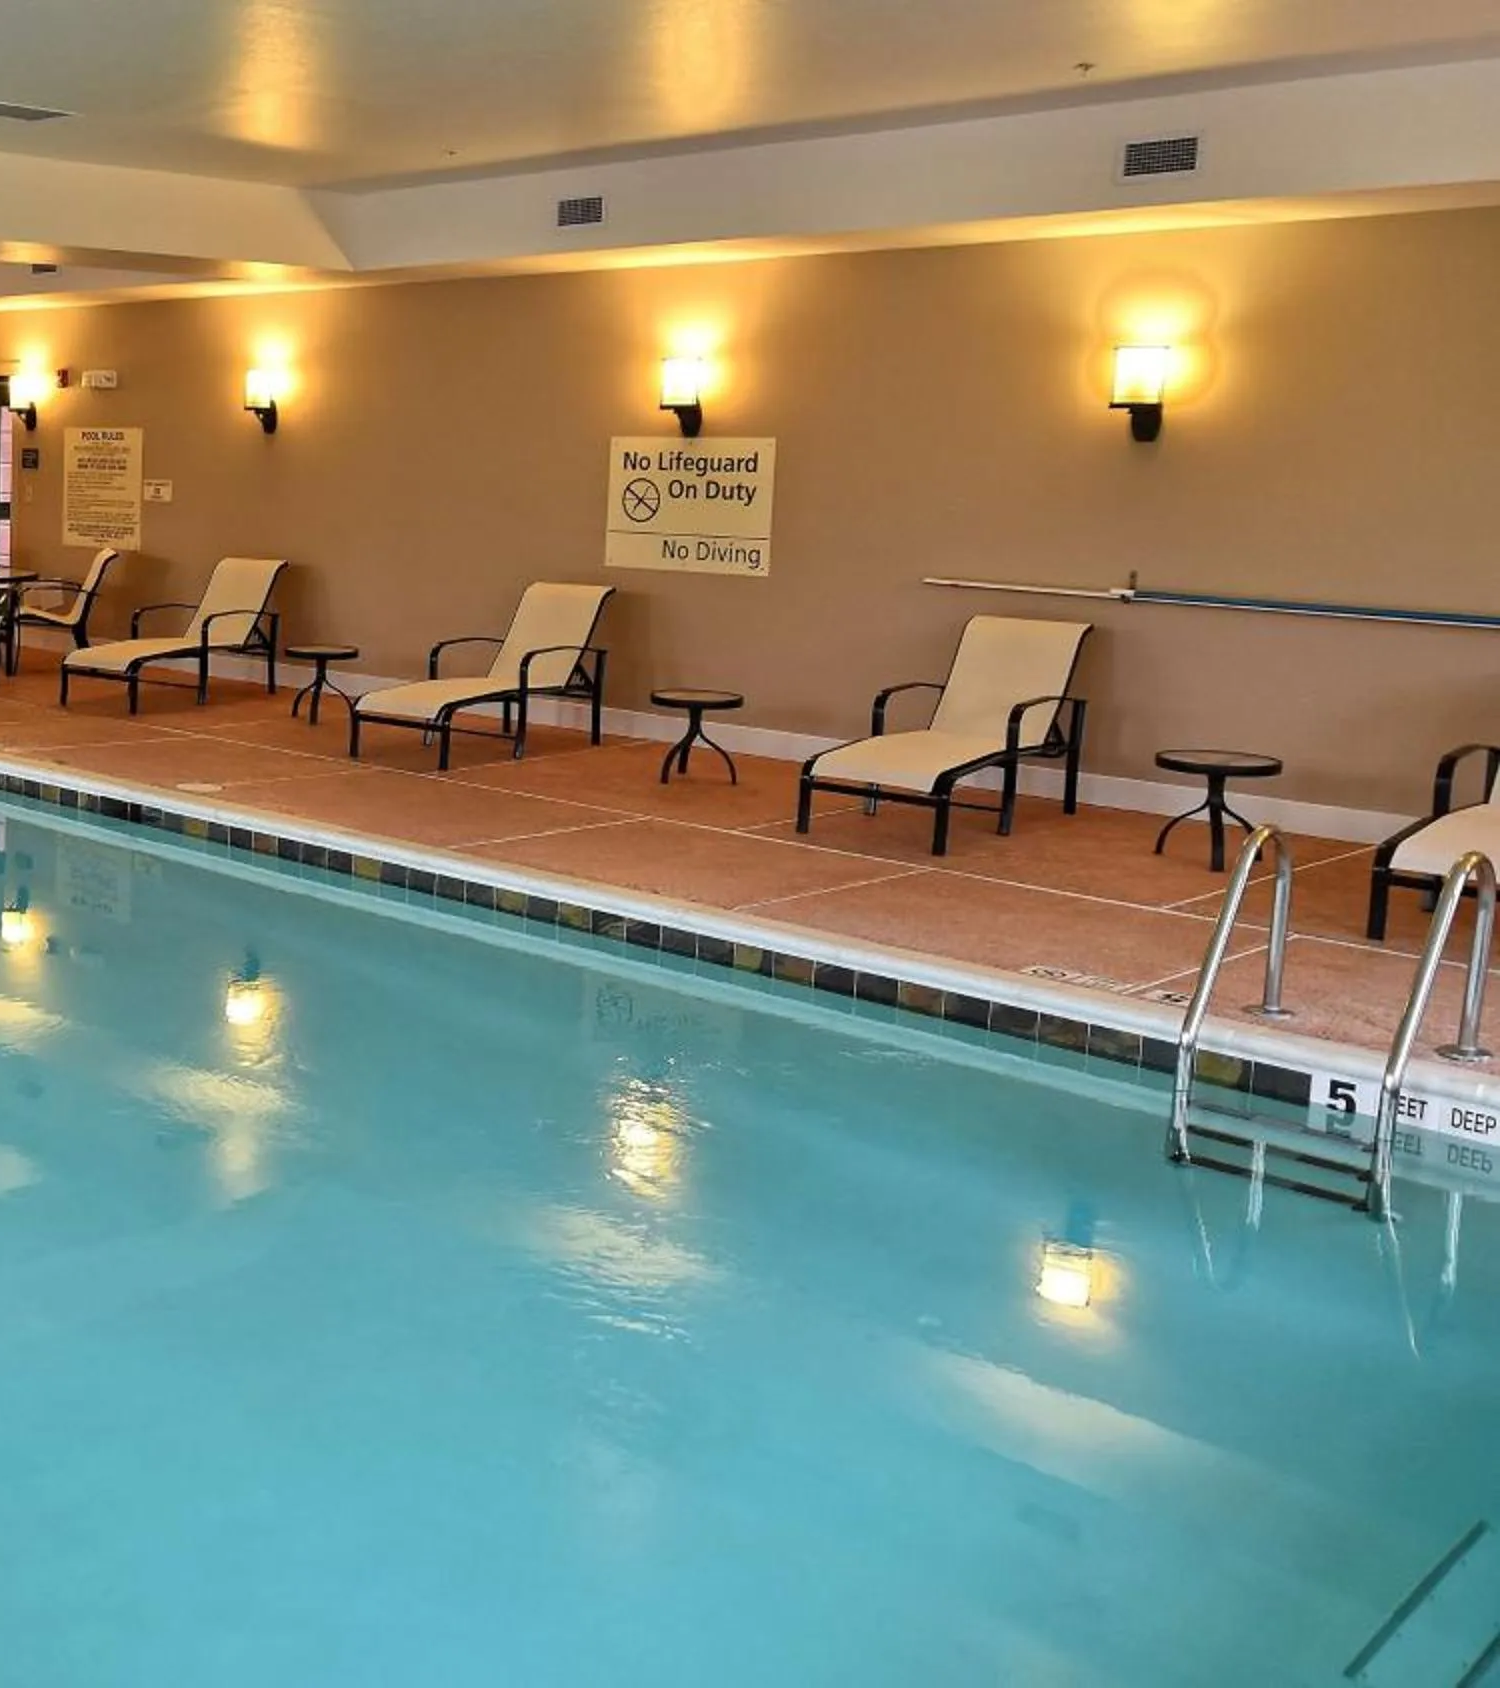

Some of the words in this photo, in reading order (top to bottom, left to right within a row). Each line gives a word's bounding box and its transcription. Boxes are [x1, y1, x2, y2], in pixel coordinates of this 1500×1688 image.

[623, 451, 651, 471] No
[658, 451, 759, 477] Lifeguard
[668, 479, 697, 499] On
[705, 480, 757, 507] Duty
[661, 540, 689, 559] No
[696, 541, 761, 569] Diving
[1326, 1079, 1357, 1113] 5
[1397, 1095, 1428, 1121] EET
[1451, 1106, 1497, 1135] DEEP
